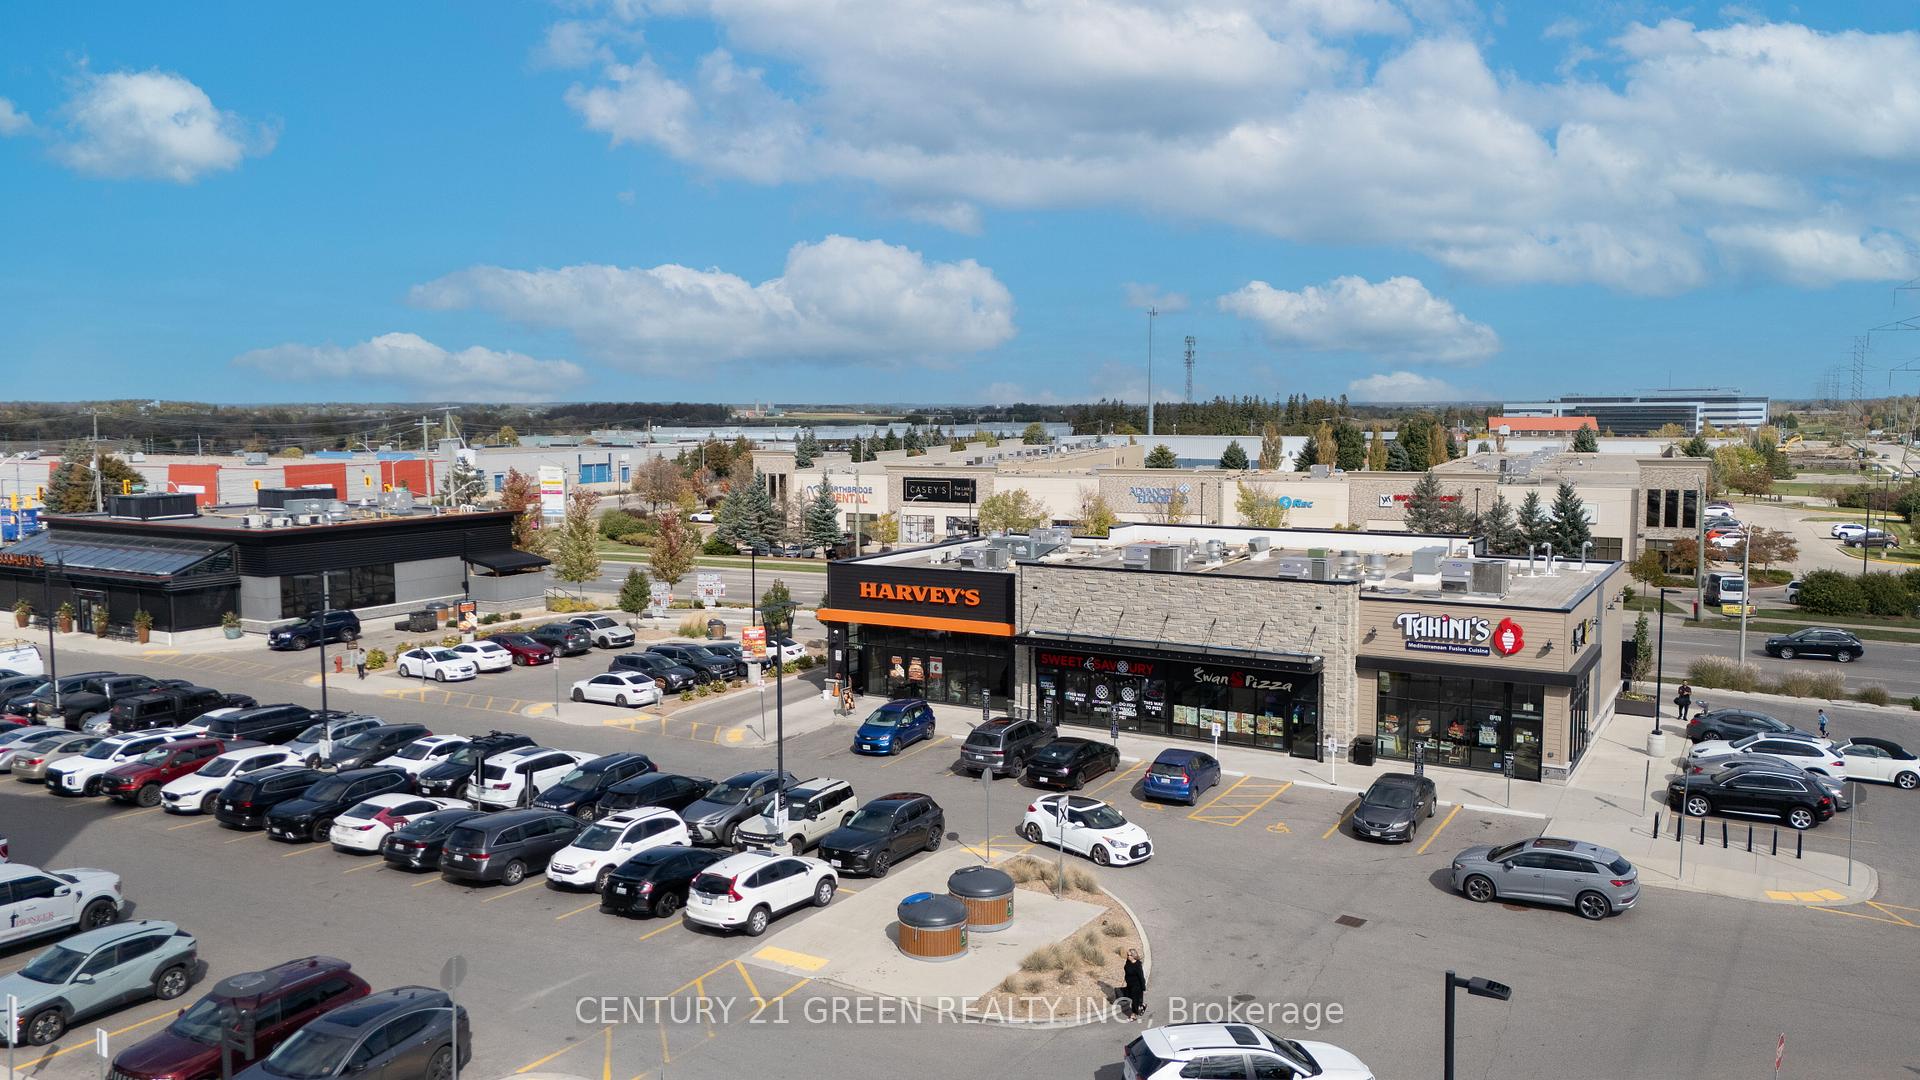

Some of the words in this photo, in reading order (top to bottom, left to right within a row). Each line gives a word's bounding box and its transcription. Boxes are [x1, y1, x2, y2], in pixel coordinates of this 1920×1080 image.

[910, 485, 947, 494] CASEY'S
[859, 581, 982, 607] HARVEY'S
[1407, 642, 1448, 651] Mediterranean
[1448, 645, 1467, 653] Fusion
[1468, 647, 1489, 655] Cuisine
[1041, 654, 1083, 668] SWEET
[1193, 669, 1229, 685] Swan
[1245, 675, 1293, 692] Pizza
[1489, 714, 1502, 722] OPEN
